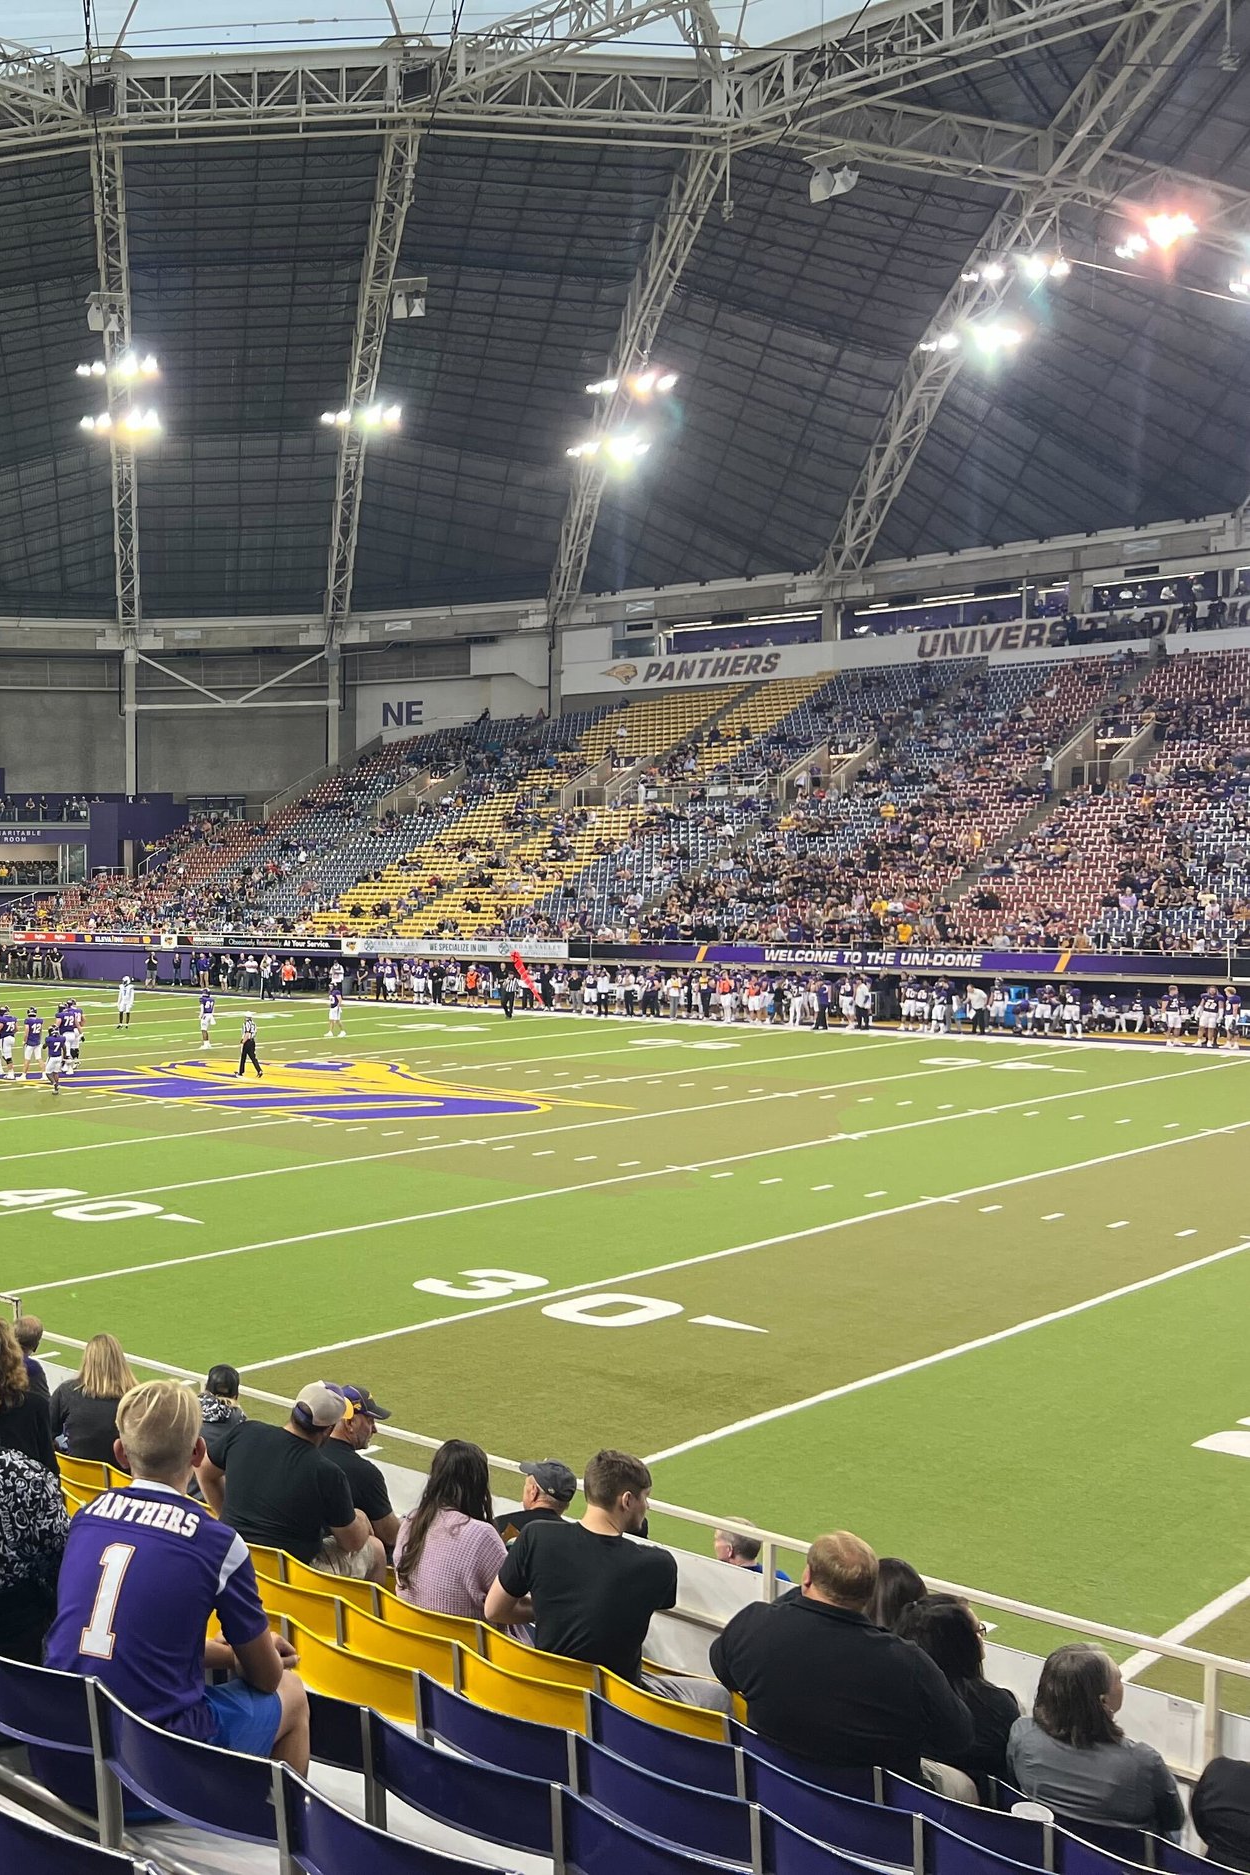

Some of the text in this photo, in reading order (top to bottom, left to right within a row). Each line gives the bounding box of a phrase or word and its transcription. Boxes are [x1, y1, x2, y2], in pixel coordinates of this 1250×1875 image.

[642, 652, 782, 683] PANTHERS
[382, 701, 423, 727] NE
[306, 940, 330, 948] Service.
[429, 943, 487, 952] WE SPECIALIZE IN UNI
[764, 949, 983, 967] WELCOME TO THE UNI-DOME
[6, 1021, 15, 1032] 75
[64, 1016, 74, 1026] 72
[31, 1024, 41, 1034] 12
[54, 1042, 61, 1052] 7
[413, 1268, 685, 1327] 30
[79, 1542, 136, 1661] 1
